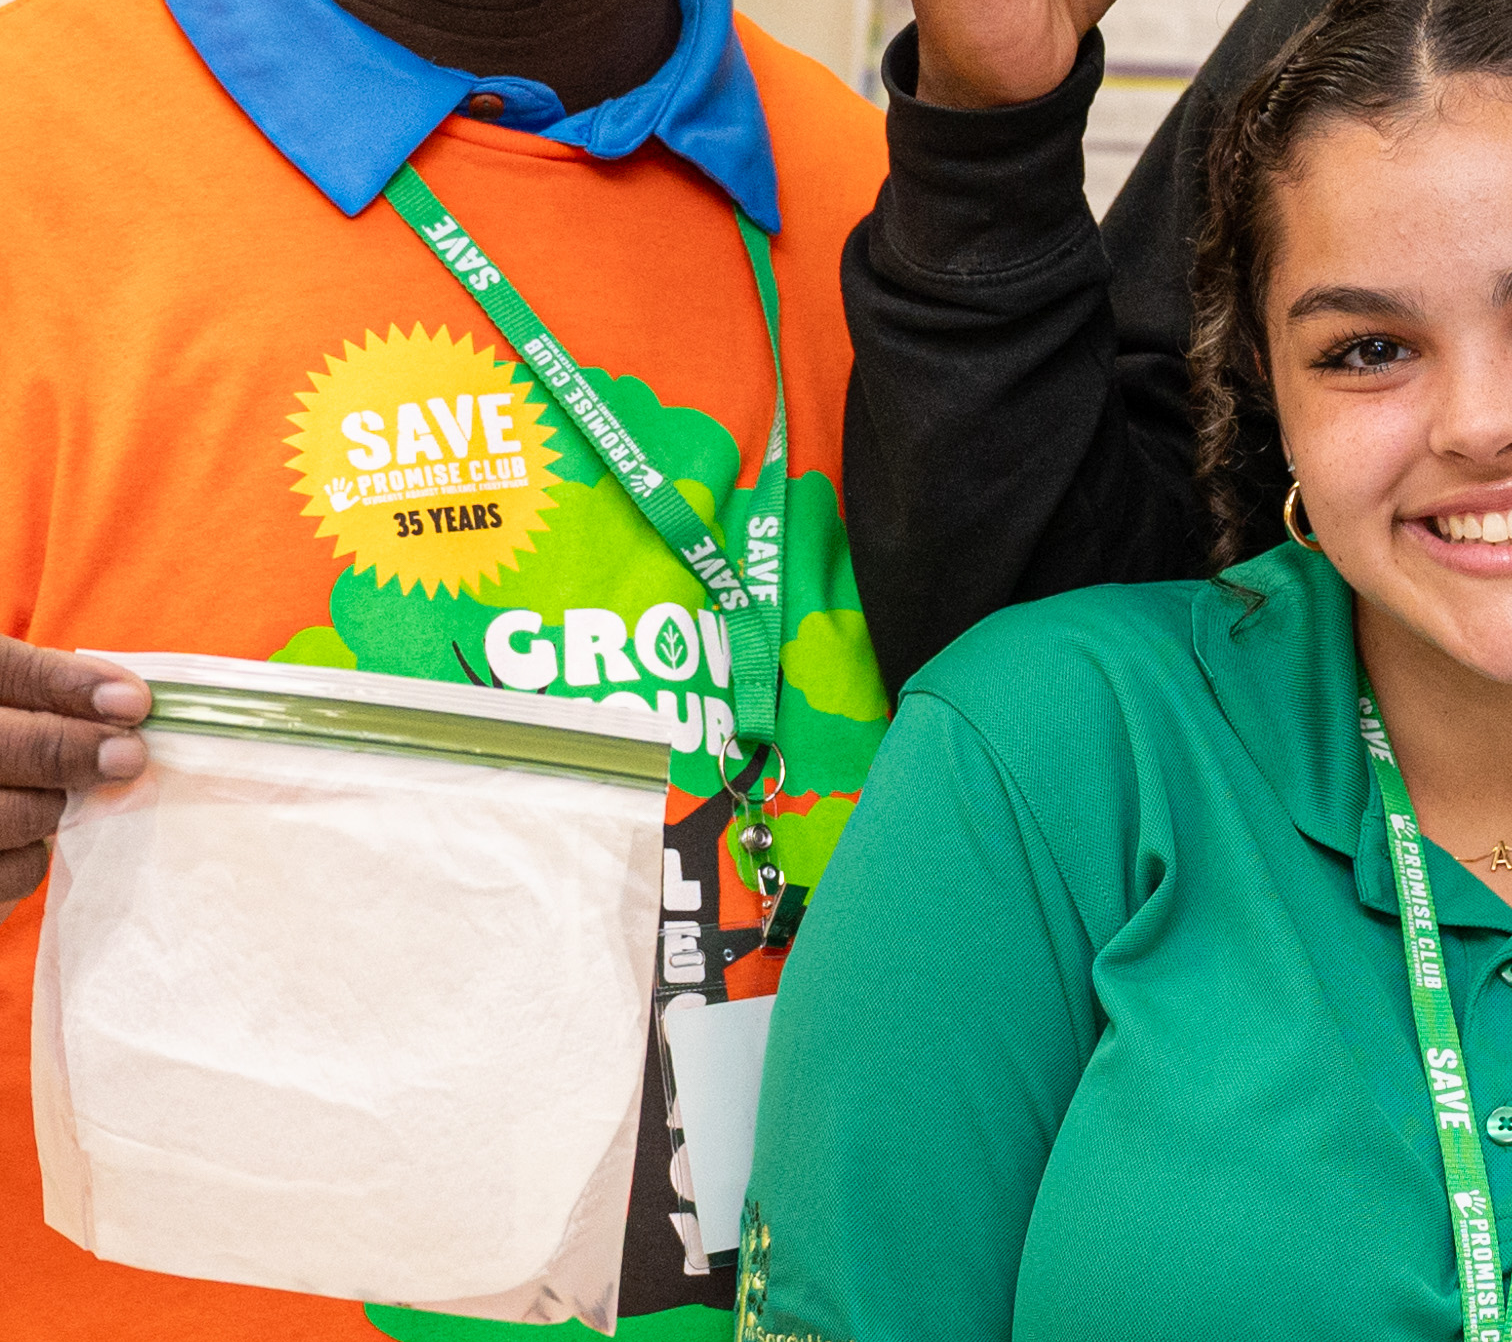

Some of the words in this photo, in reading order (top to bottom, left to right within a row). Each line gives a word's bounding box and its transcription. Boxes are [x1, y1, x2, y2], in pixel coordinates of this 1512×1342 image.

[424, 214, 500, 291] SAVE
[523, 338, 572, 388] CLUB
[341, 392, 522, 471] SAVE
[565, 387, 638, 474] PROMISE
[356, 462, 463, 496] PROMISE
[469, 456, 527, 483] CLUB
[393, 510, 424, 538] 35
[426, 503, 503, 534] YEARS
[683, 536, 749, 611] SAVE
[747, 516, 778, 606] SAVE
[1401, 841, 1434, 930] PROMISE
[1417, 936, 1443, 989] CLUB
[1426, 1047, 1472, 1134] SAVE
[1468, 1218, 1499, 1321] PROMISE
